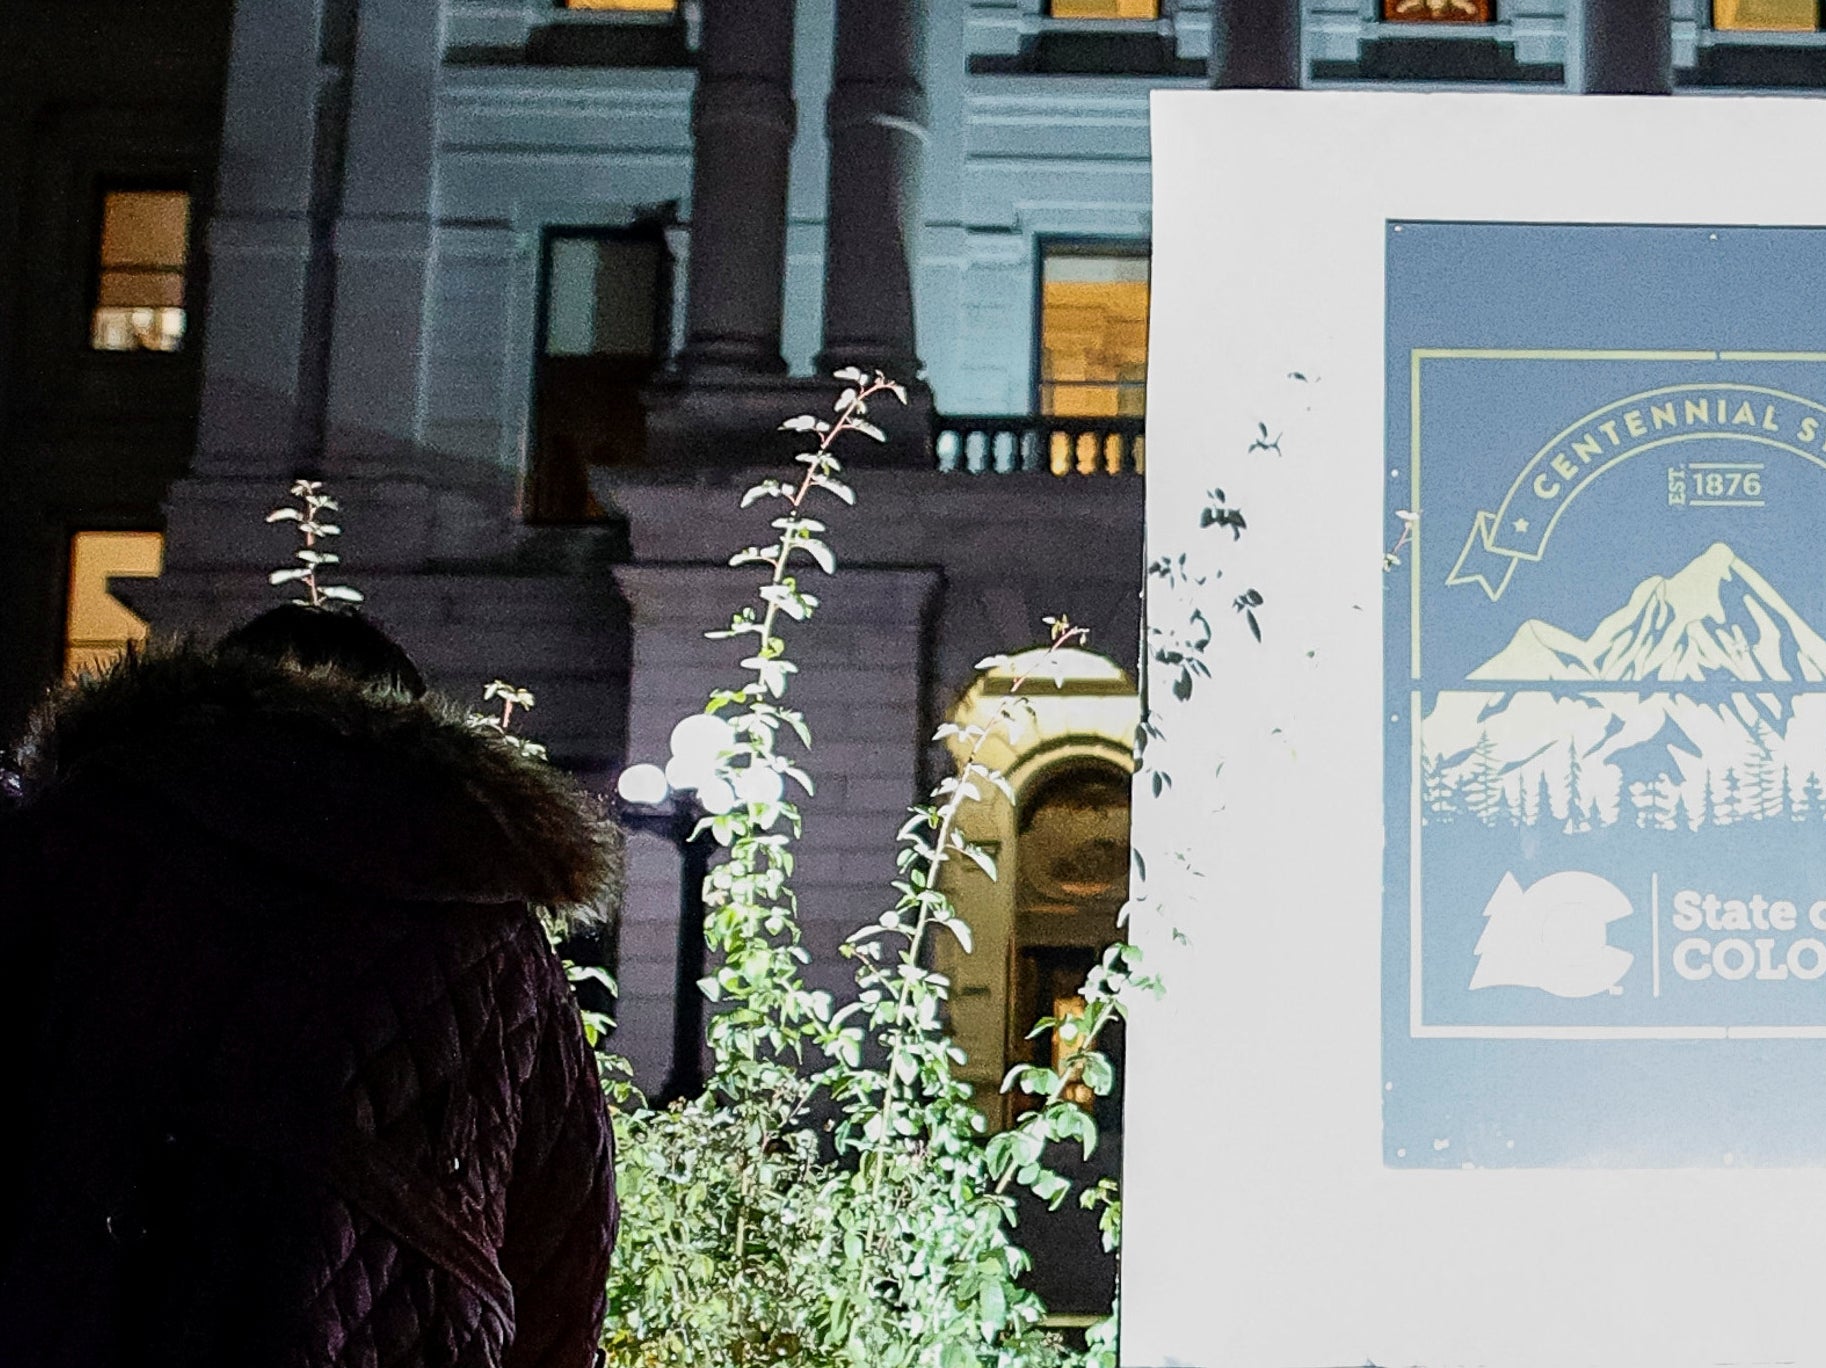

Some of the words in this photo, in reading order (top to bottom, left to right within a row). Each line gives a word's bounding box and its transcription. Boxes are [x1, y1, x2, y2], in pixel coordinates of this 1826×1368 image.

[1533, 398, 1780, 501] CENTENNIAL
[1667, 463, 1686, 506] EST.
[1692, 471, 1762, 496] 1876
[1672, 891, 1797, 931] State
